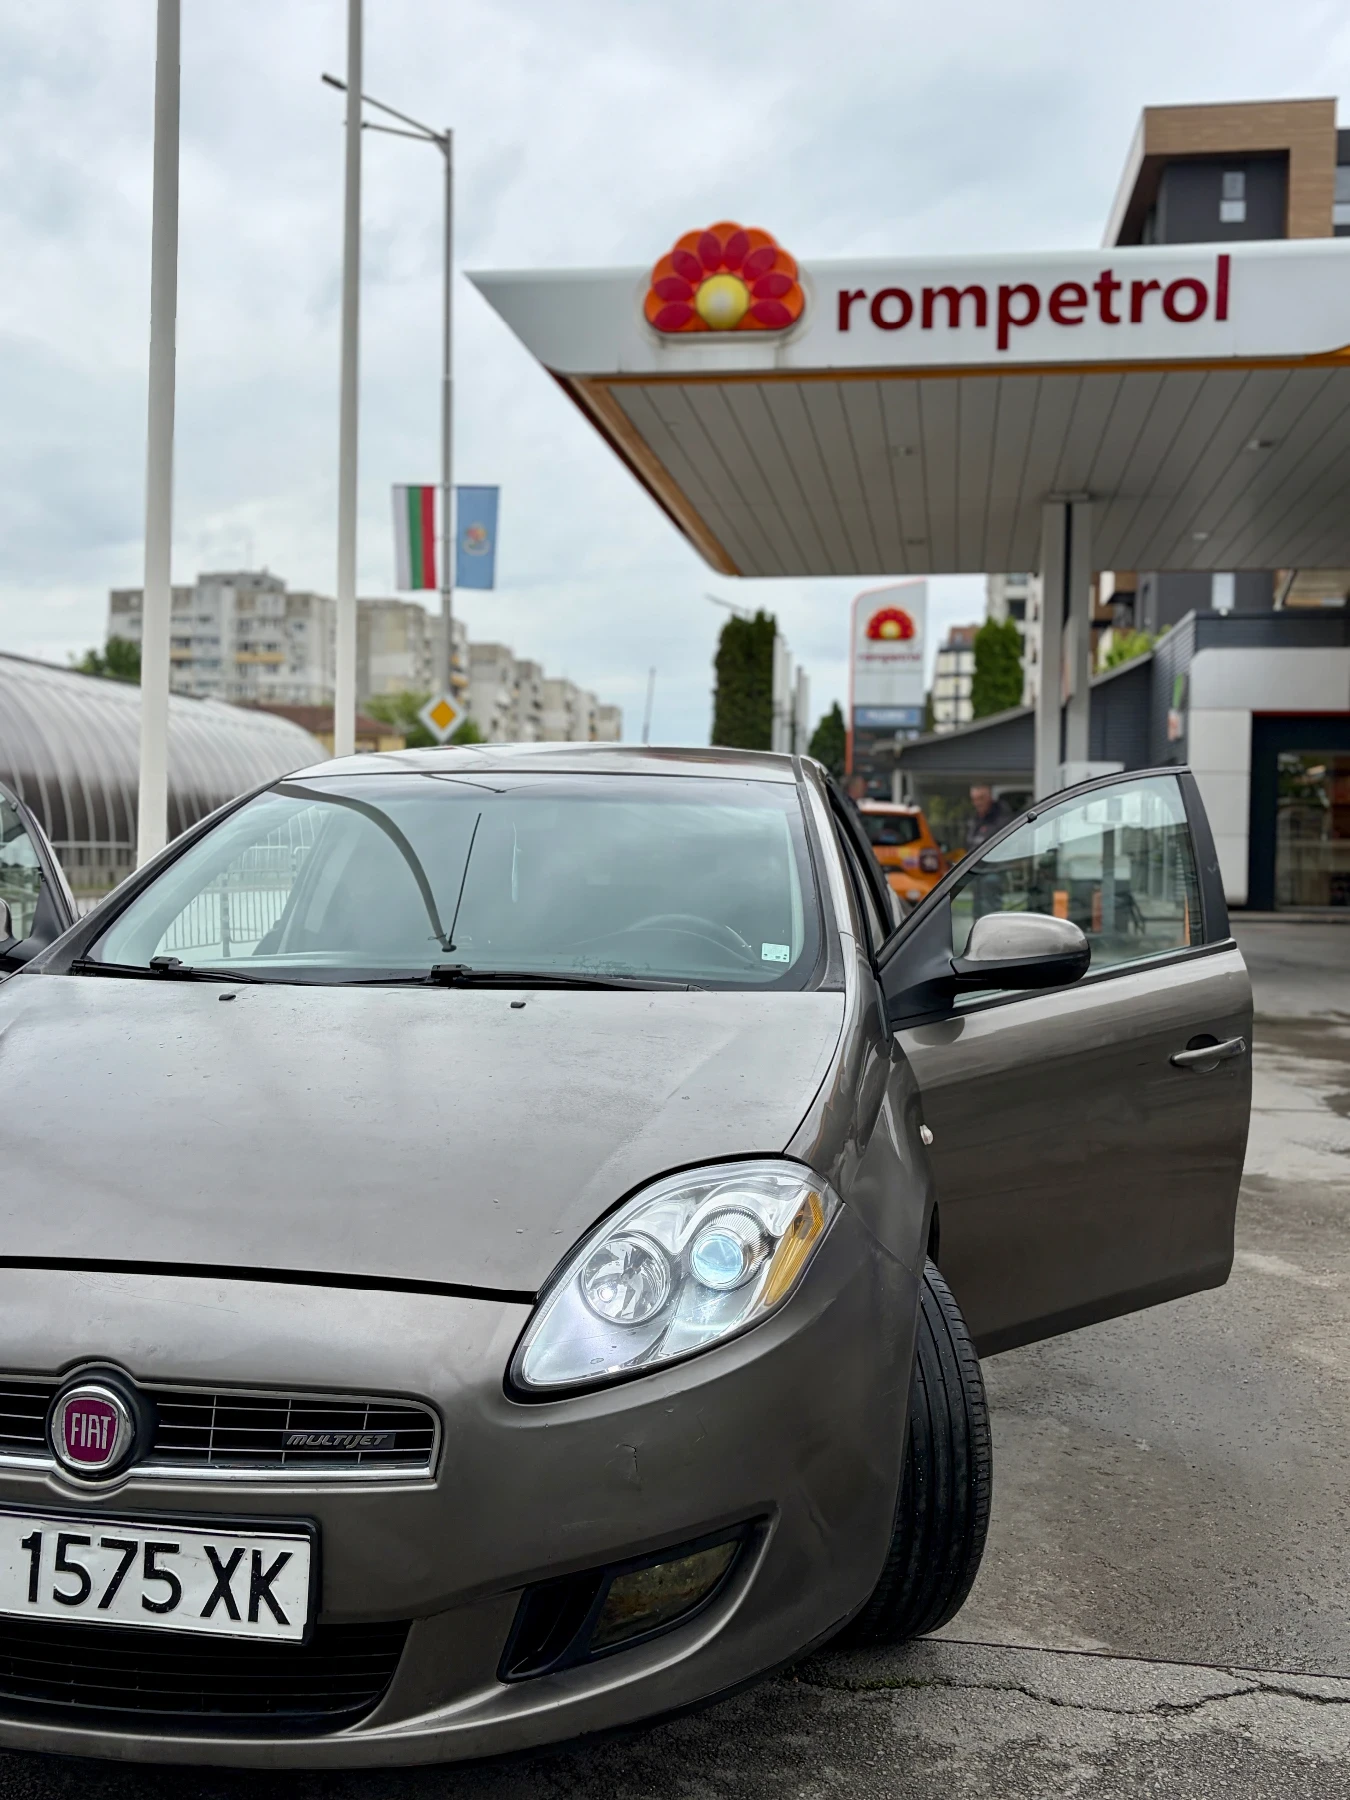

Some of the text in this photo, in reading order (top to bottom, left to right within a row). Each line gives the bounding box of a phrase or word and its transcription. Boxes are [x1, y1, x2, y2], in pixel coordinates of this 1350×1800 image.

[838, 254, 1230, 350] rompetrol
[70, 1412, 112, 1450] FIAT
[286, 1434, 388, 1449] MULTIJET
[21, 1530, 294, 1625] 1575 XK
